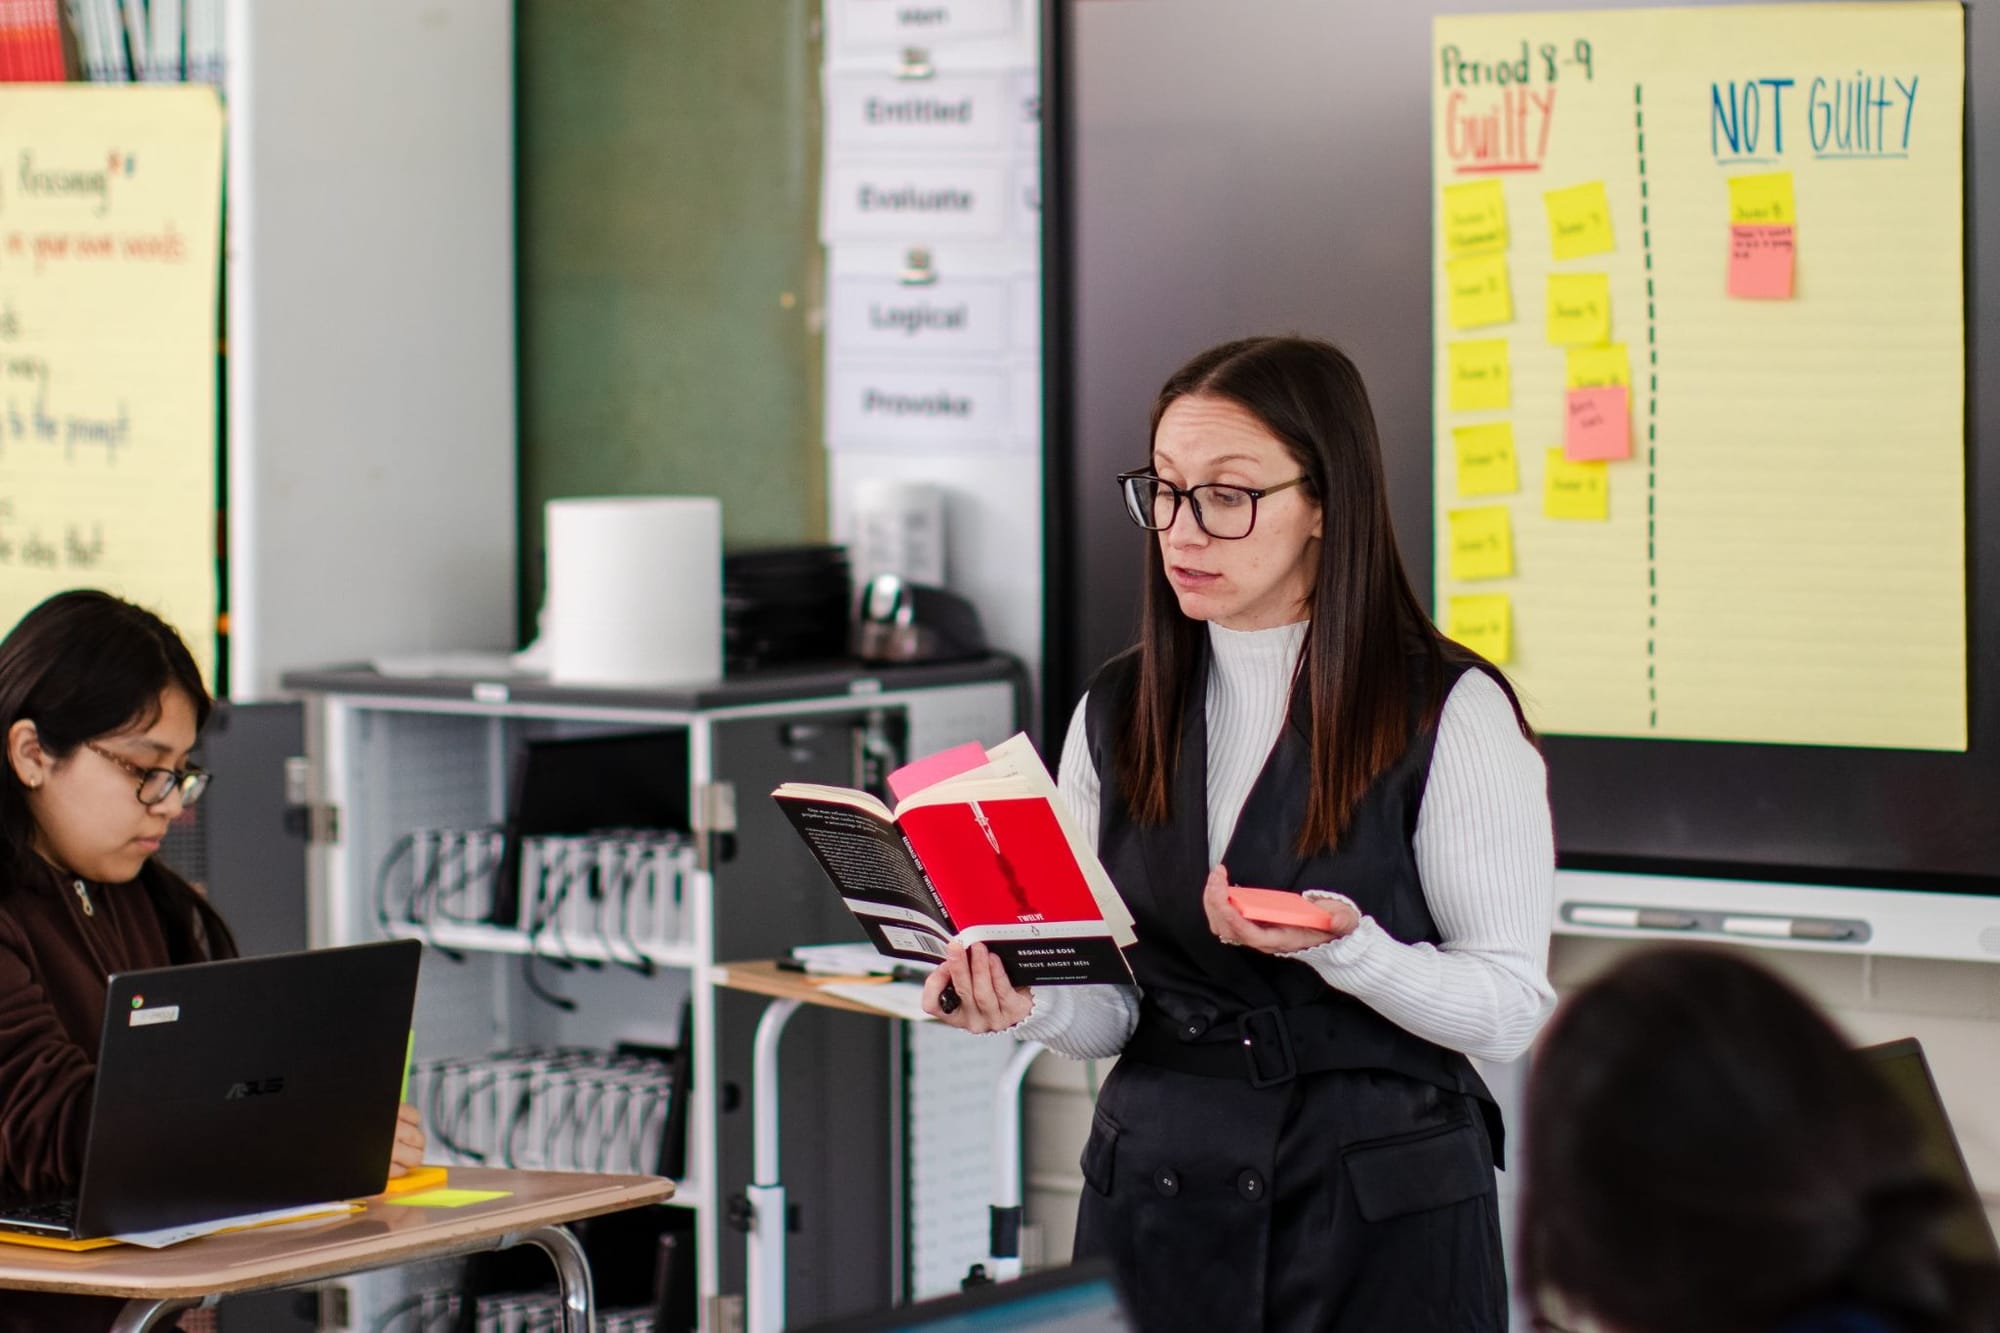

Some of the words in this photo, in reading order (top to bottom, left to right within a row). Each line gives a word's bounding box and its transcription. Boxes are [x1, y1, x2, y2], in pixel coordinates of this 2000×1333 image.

[1441, 40, 1530, 86] Period
[866, 97, 971, 124] Entitled
[1711, 79, 1794, 156] NOT
[858, 184, 974, 210] Evaluate
[870, 305, 966, 336] Logical
[863, 391, 972, 417] Provoke
[902, 835, 917, 859] REGINALD
[914, 858, 924, 871] ROSE
[923, 874, 935, 892] TWELVE
[932, 891, 943, 908] ANGRY
[940, 907, 949, 919] MEN
[1017, 912, 1045, 923] TWELVE
[1017, 948, 1055, 957] REGINALD
[1056, 947, 1076, 955] ROSE
[1018, 961, 1045, 969] TWELVE
[1047, 960, 1071, 968] ANGRY
[225, 1077, 285, 1100] ASUS
